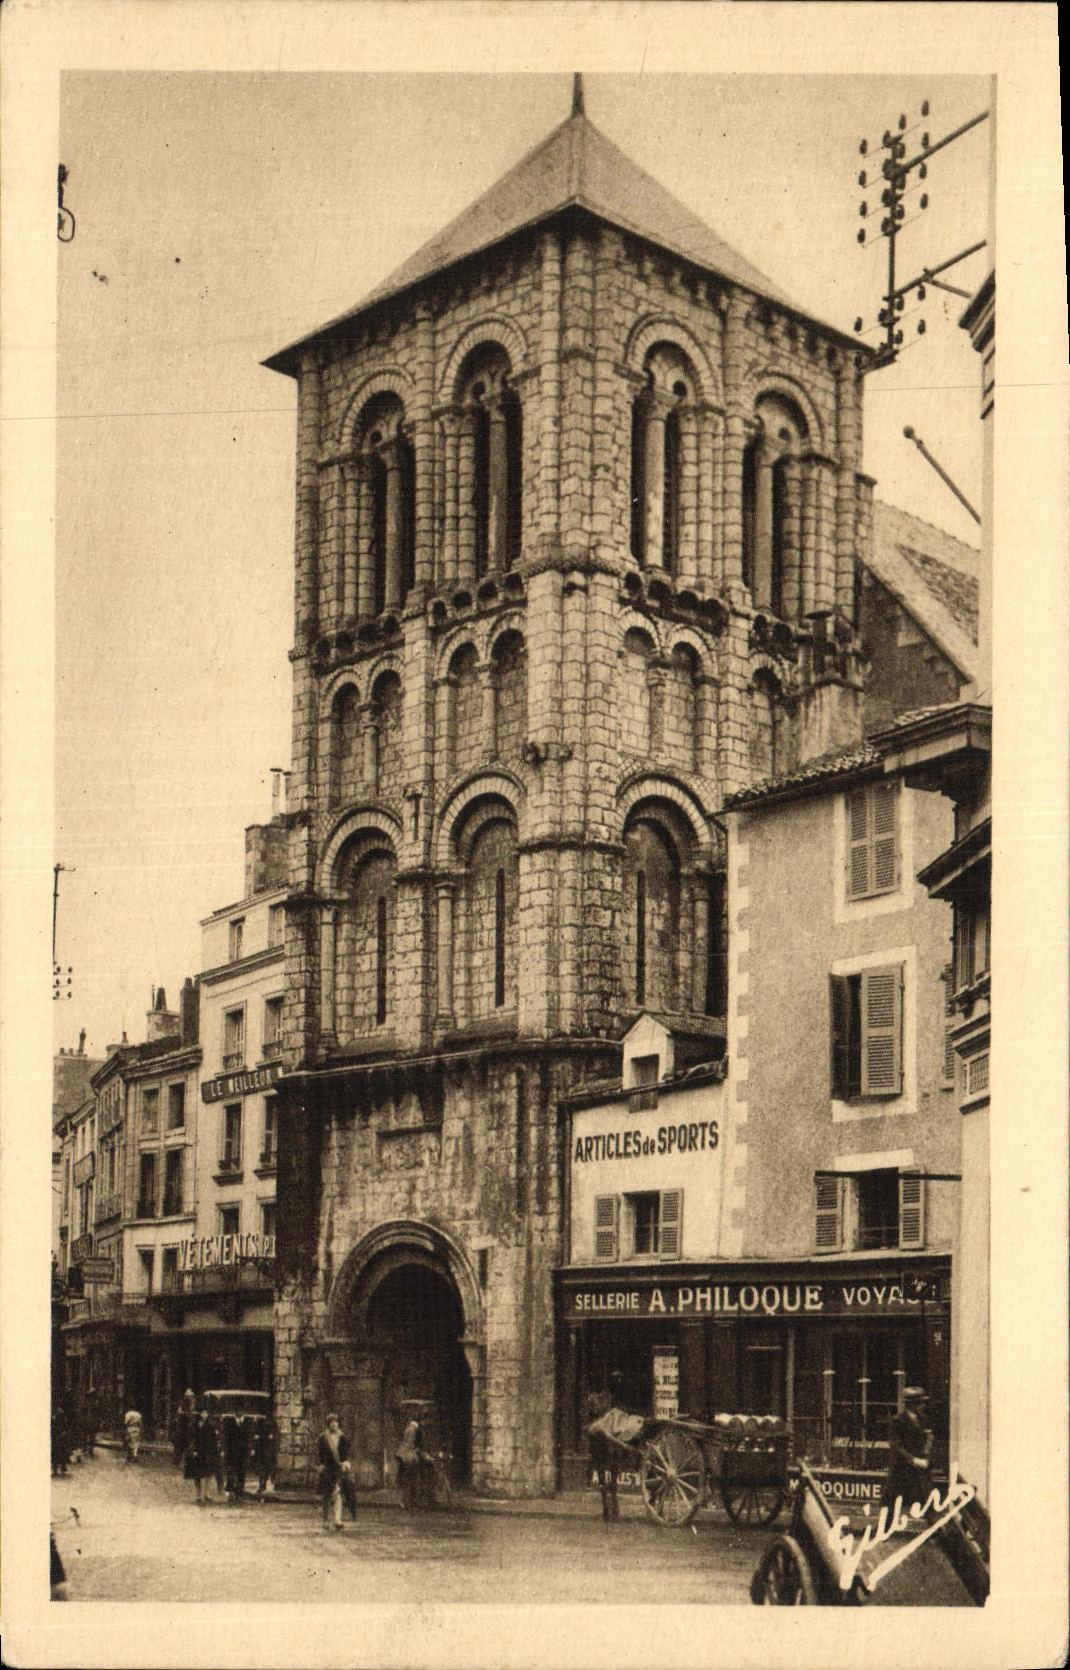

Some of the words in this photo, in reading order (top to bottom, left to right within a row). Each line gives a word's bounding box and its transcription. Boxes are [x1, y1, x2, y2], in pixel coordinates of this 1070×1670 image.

[211, 1080, 223, 1097] LE
[574, 1130, 642, 1163] ARTICLES
[643, 1135, 656, 1156] de
[657, 1120, 719, 1155] SPORTS
[575, 1292, 640, 1311] SELLERIE
[678, 1285, 824, 1316] PHILOQUE
